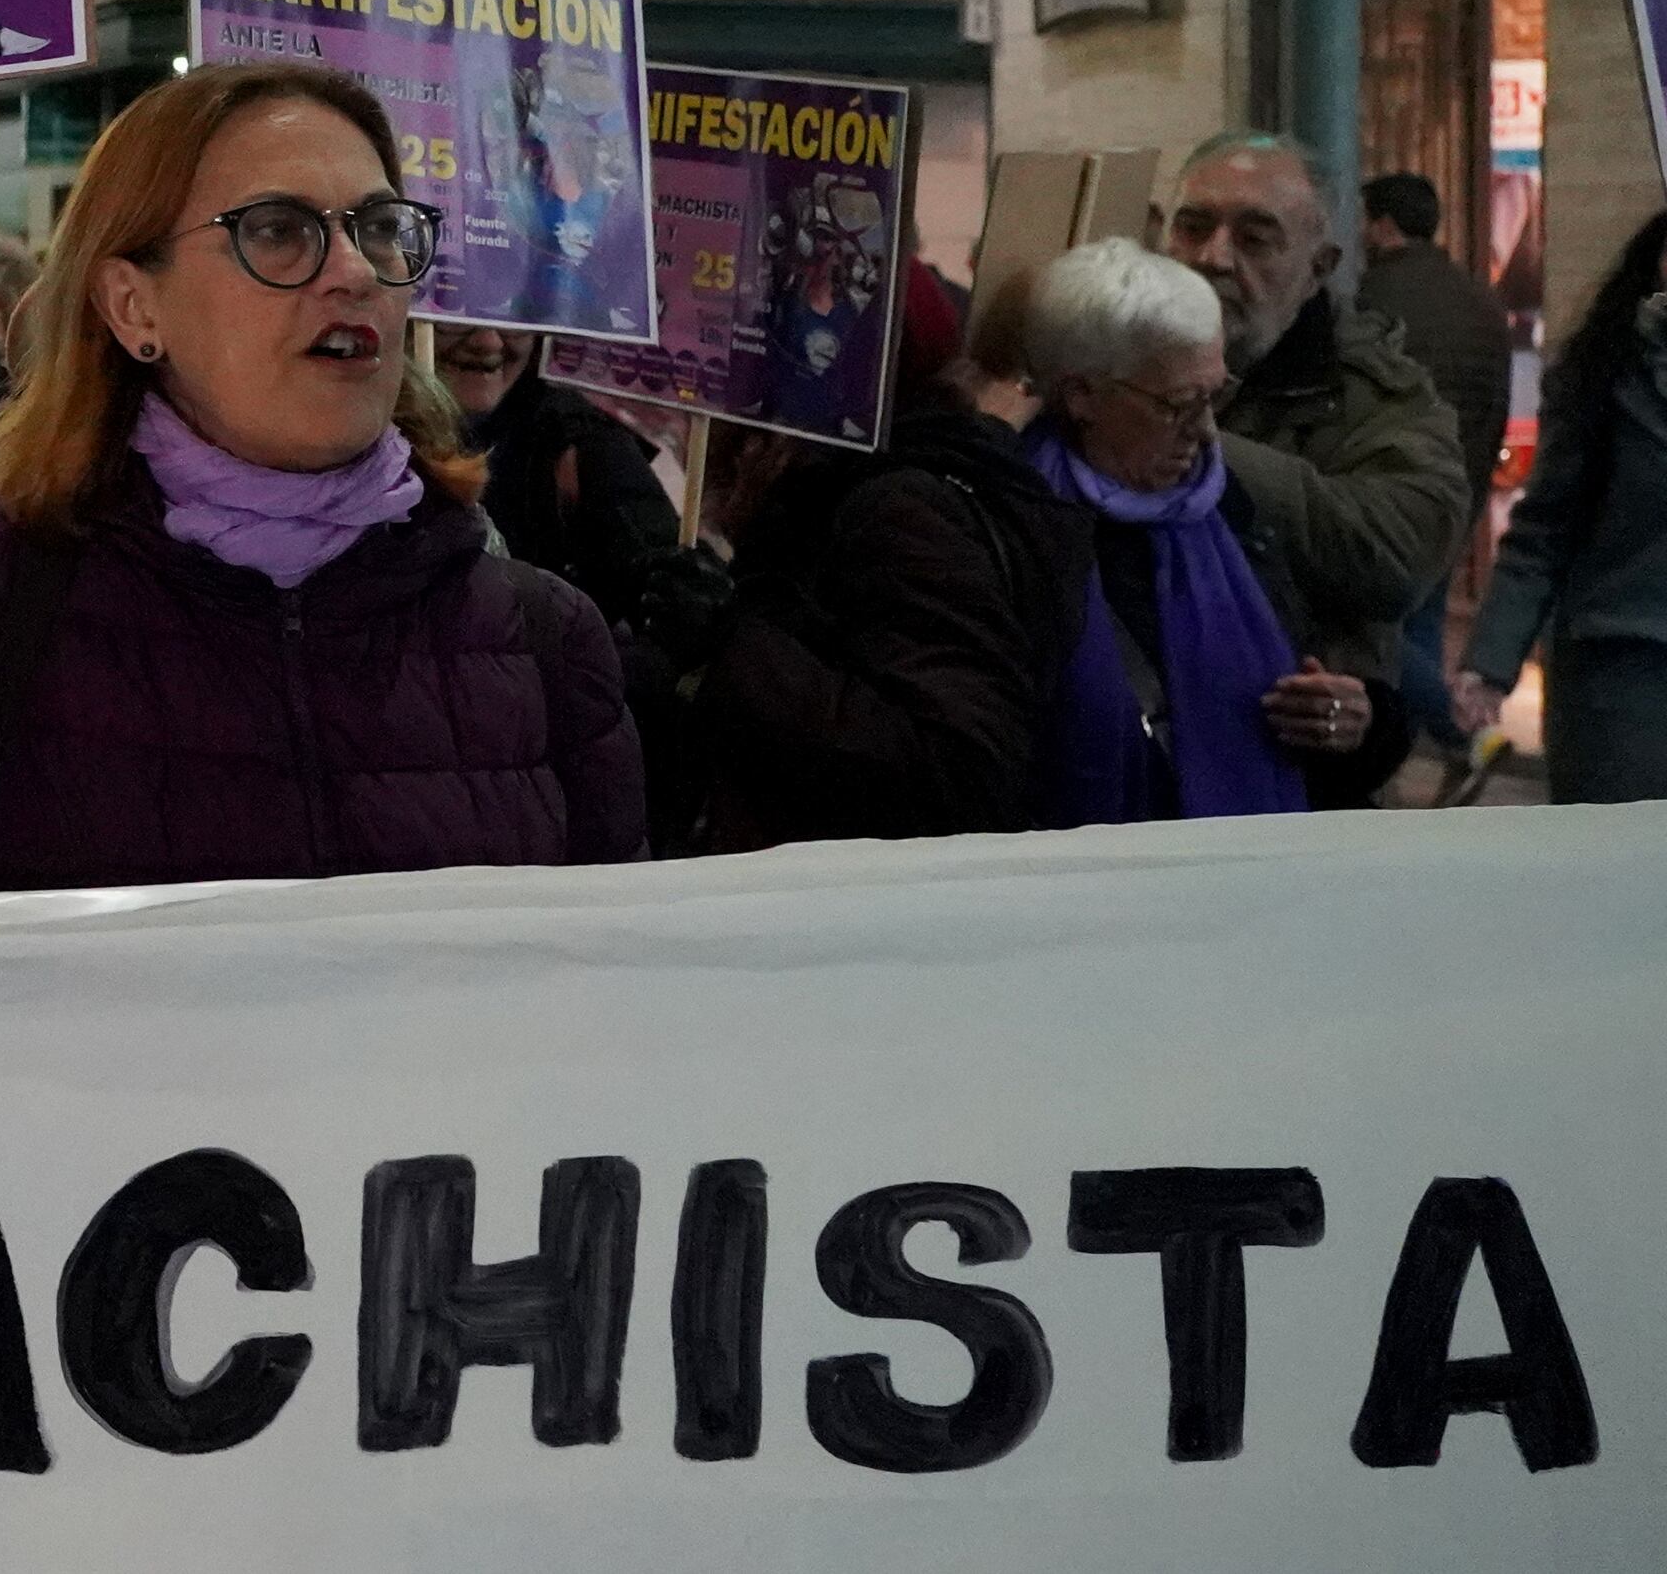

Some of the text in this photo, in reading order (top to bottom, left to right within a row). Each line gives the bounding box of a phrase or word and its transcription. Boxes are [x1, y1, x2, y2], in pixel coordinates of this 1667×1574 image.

[219, 23, 324, 61] ANTE LA
[648, 94, 897, 170] NIFESTACIÓN
[400, 134, 458, 181] 25
[465, 215, 508, 231] Fuente
[657, 194, 743, 224] MACHISTA
[465, 232, 511, 249] Dorada
[692, 249, 736, 291] 25
